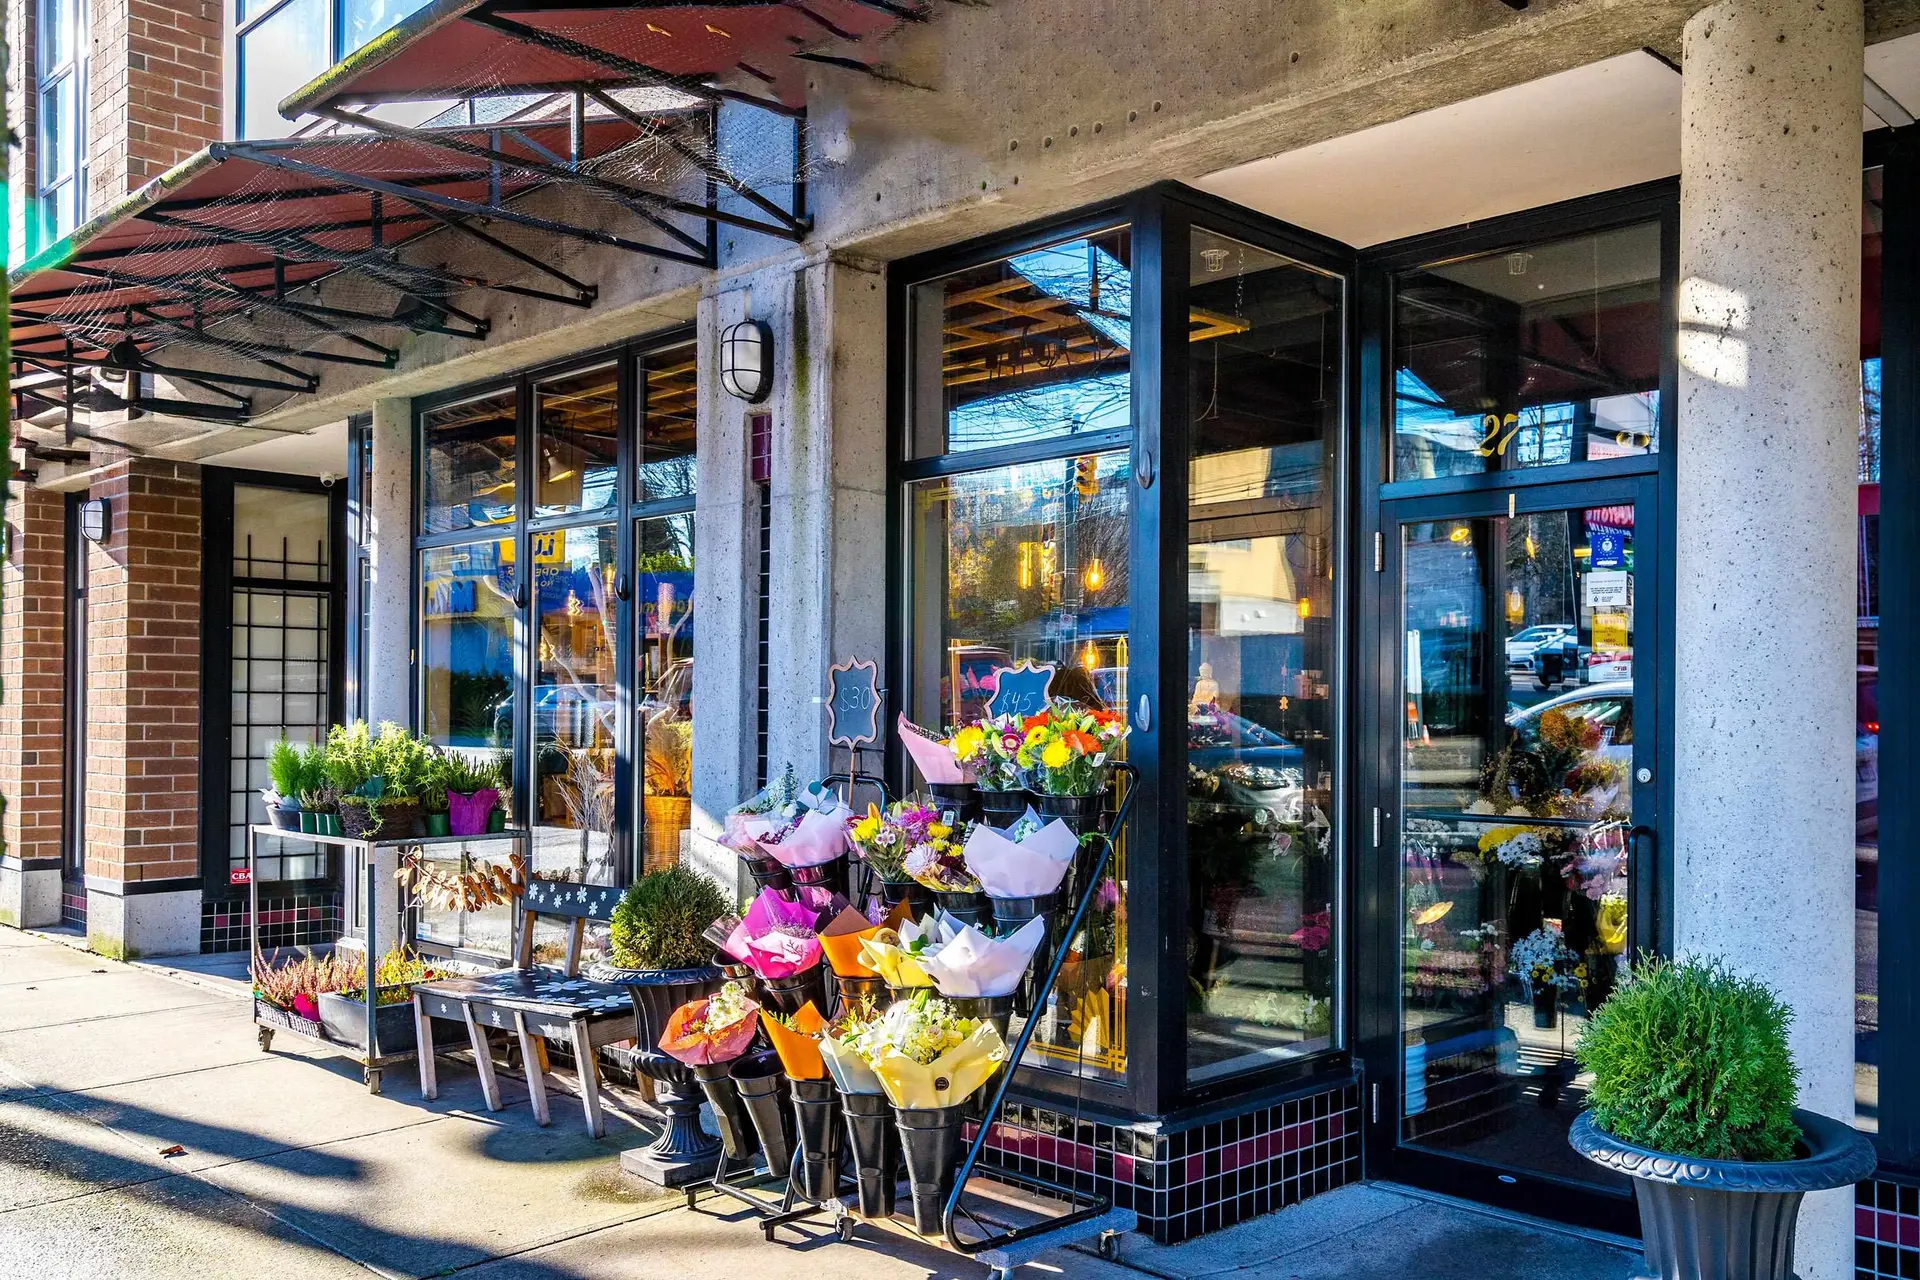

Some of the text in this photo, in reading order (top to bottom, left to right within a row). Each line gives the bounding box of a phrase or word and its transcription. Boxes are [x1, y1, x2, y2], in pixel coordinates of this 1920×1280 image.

[1480, 413, 1520, 457] 27
[839, 684, 871, 720] $30
[998, 689, 1037, 715] $45
